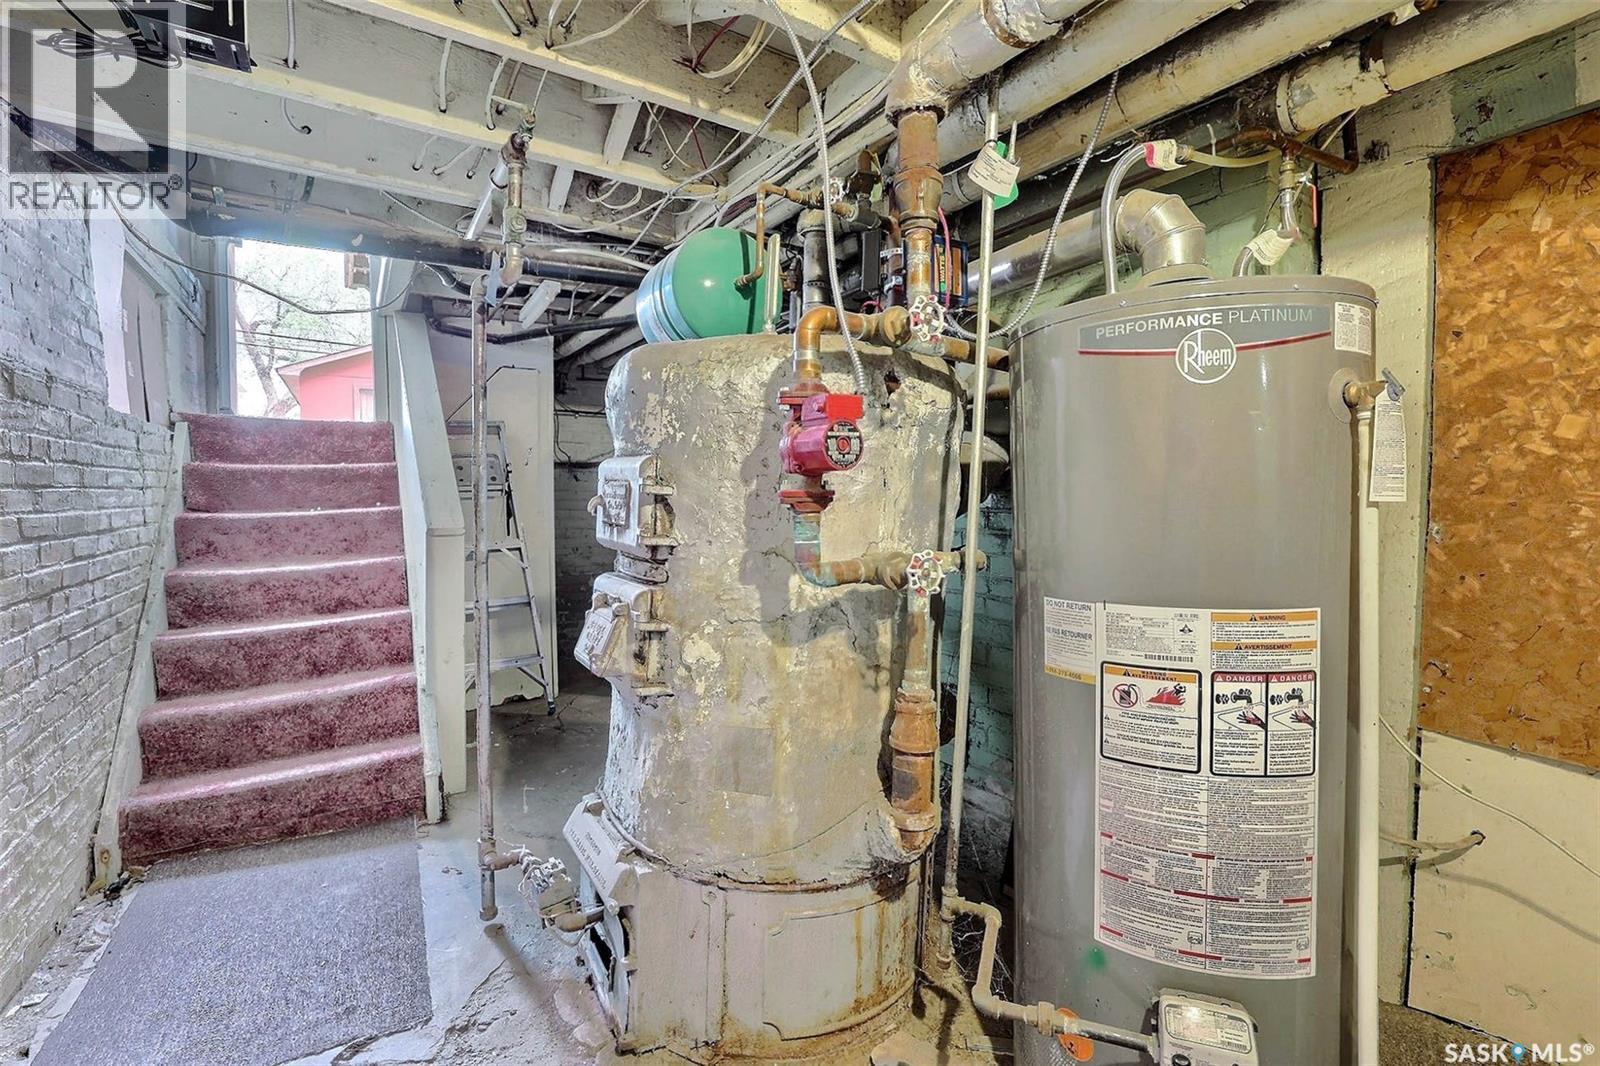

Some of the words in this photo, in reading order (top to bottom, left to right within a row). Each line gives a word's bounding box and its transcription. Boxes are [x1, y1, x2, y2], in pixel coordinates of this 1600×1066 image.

[1095, 312, 1223, 339] PERFORMANCE
[1228, 308, 1313, 324] PLATINUM
[1183, 330, 1232, 374] Rheem
[1046, 599, 1053, 607] DO
[1054, 600, 1065, 608] NOT
[1066, 602, 1092, 611] RETURN
[1061, 628, 1093, 641] RETOURNER
[1131, 673, 1177, 683] AVERTISSEMENT
[1280, 674, 1314, 682] DANGER
